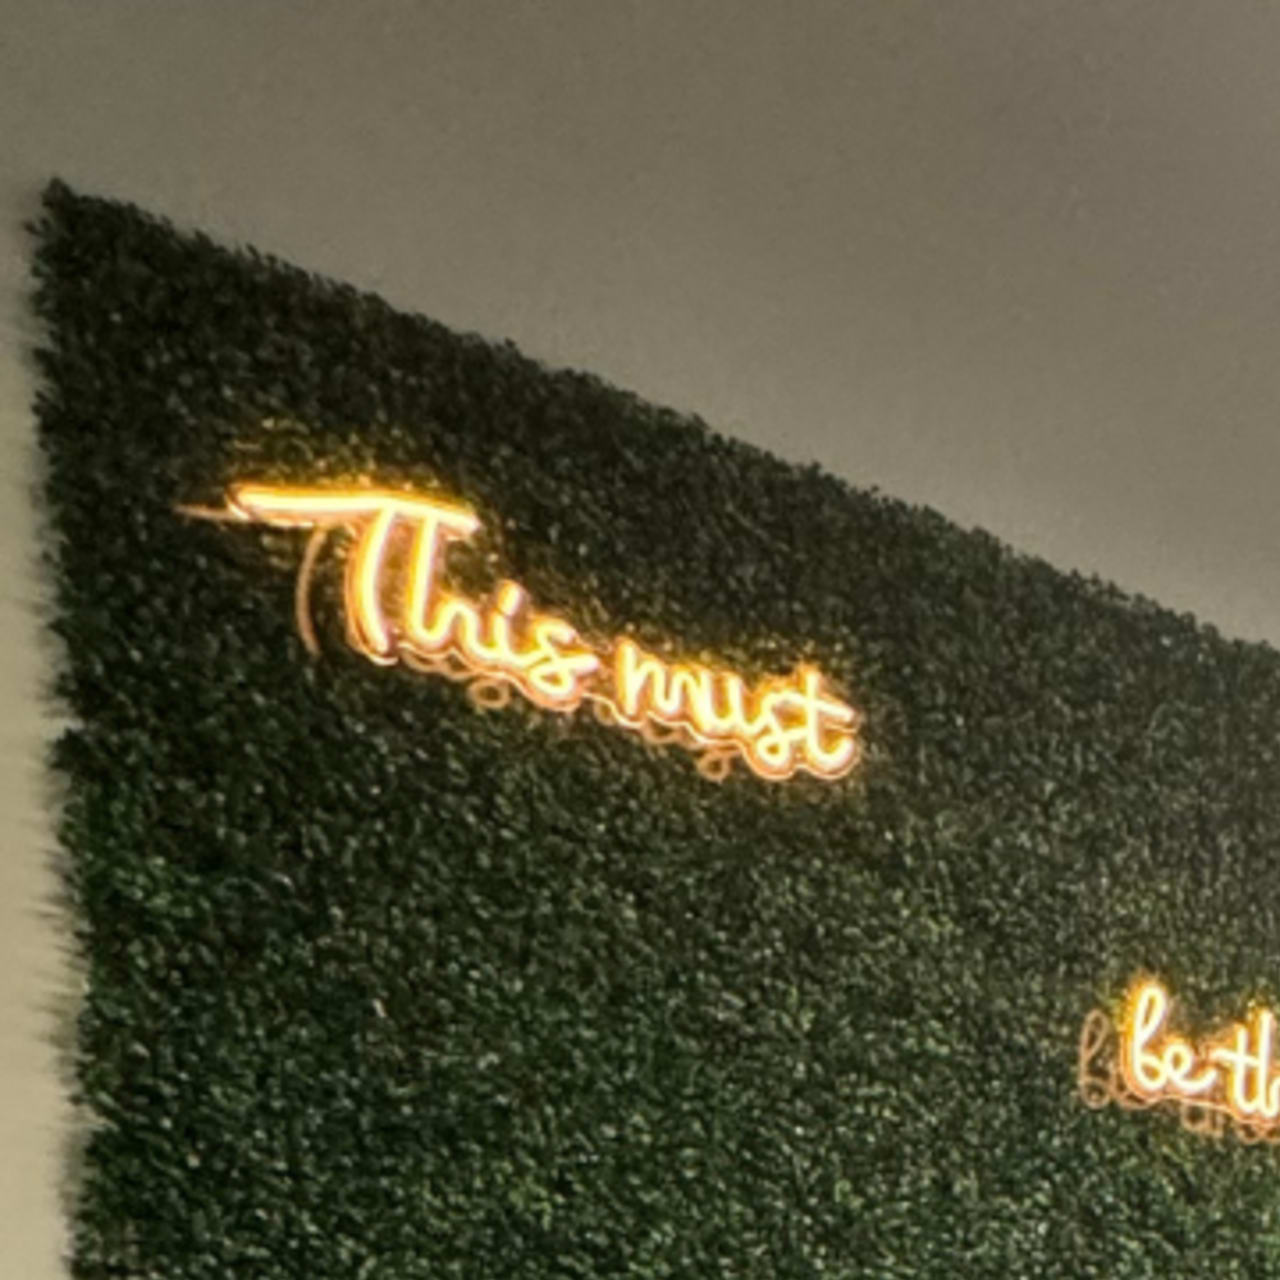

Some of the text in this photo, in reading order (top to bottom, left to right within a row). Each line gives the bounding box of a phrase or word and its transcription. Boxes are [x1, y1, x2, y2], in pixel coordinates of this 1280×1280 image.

[228, 484, 858, 780] This must
[1124, 978, 1219, 1096] be
